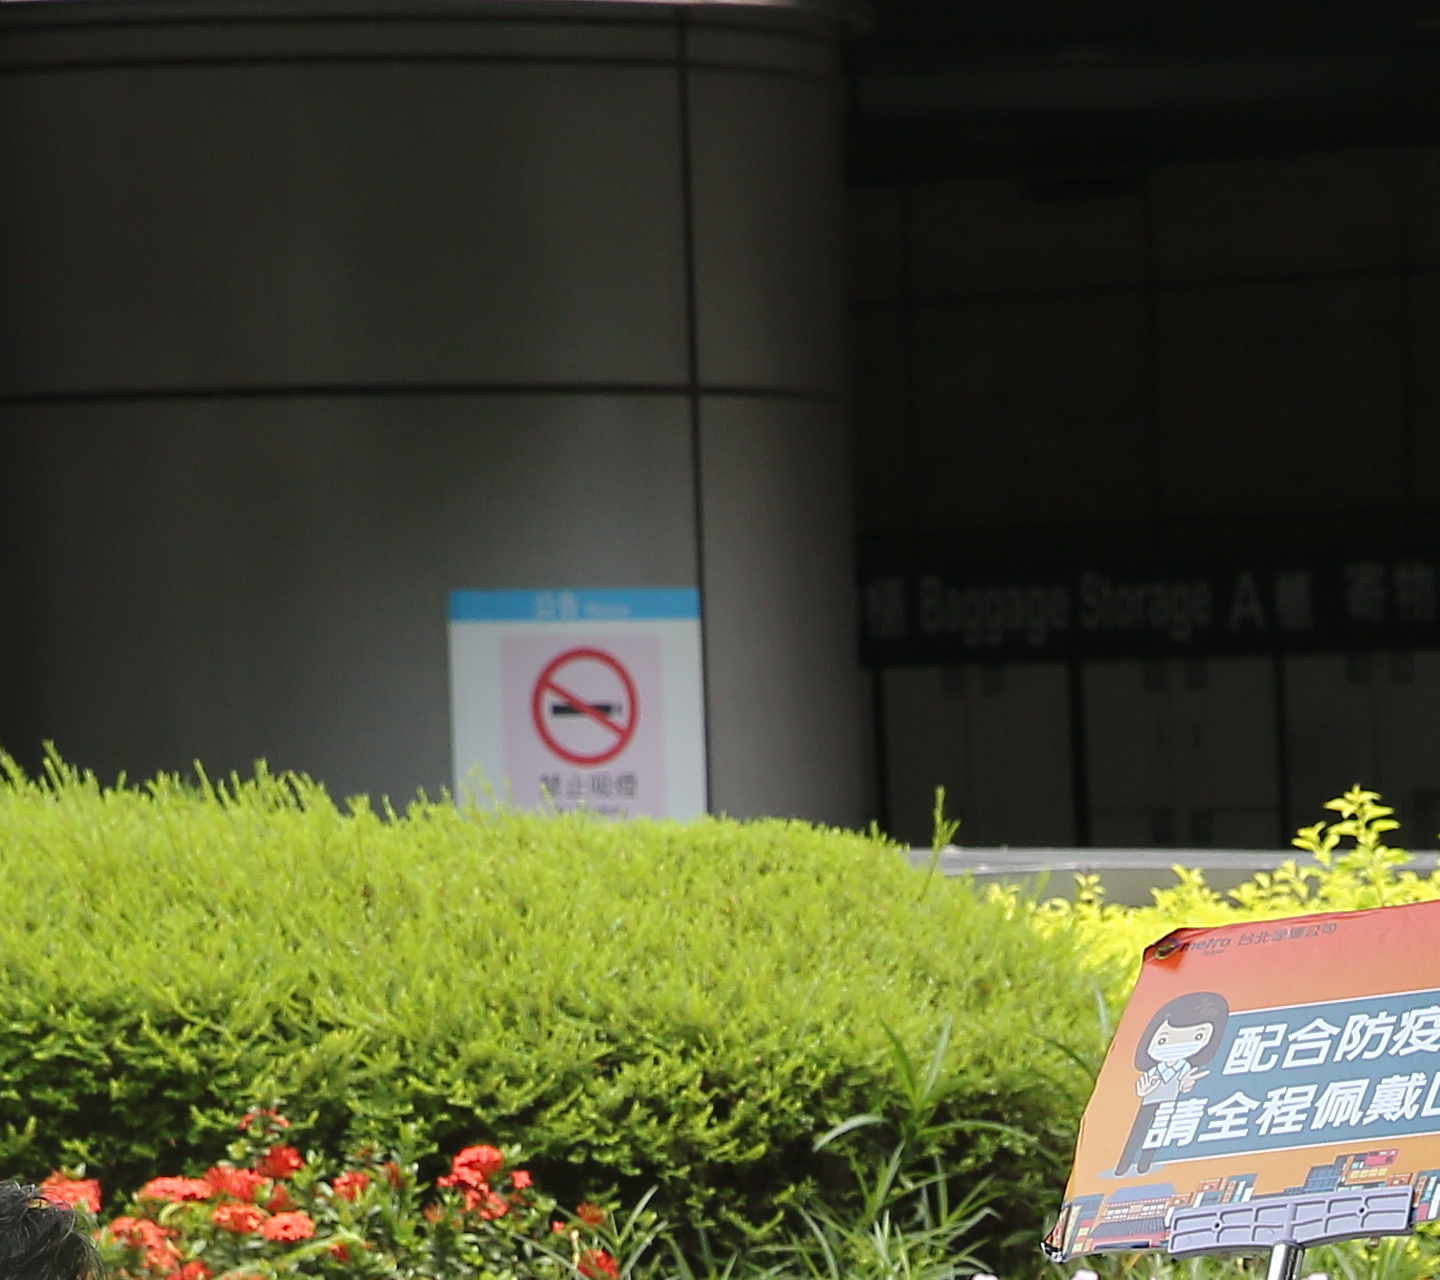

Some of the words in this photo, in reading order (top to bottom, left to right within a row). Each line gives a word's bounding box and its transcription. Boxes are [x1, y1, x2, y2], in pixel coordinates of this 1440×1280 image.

[920, 575, 1068, 647] Baggage
[1080, 572, 1213, 640] Storage
[1228, 573, 1266, 632] A
